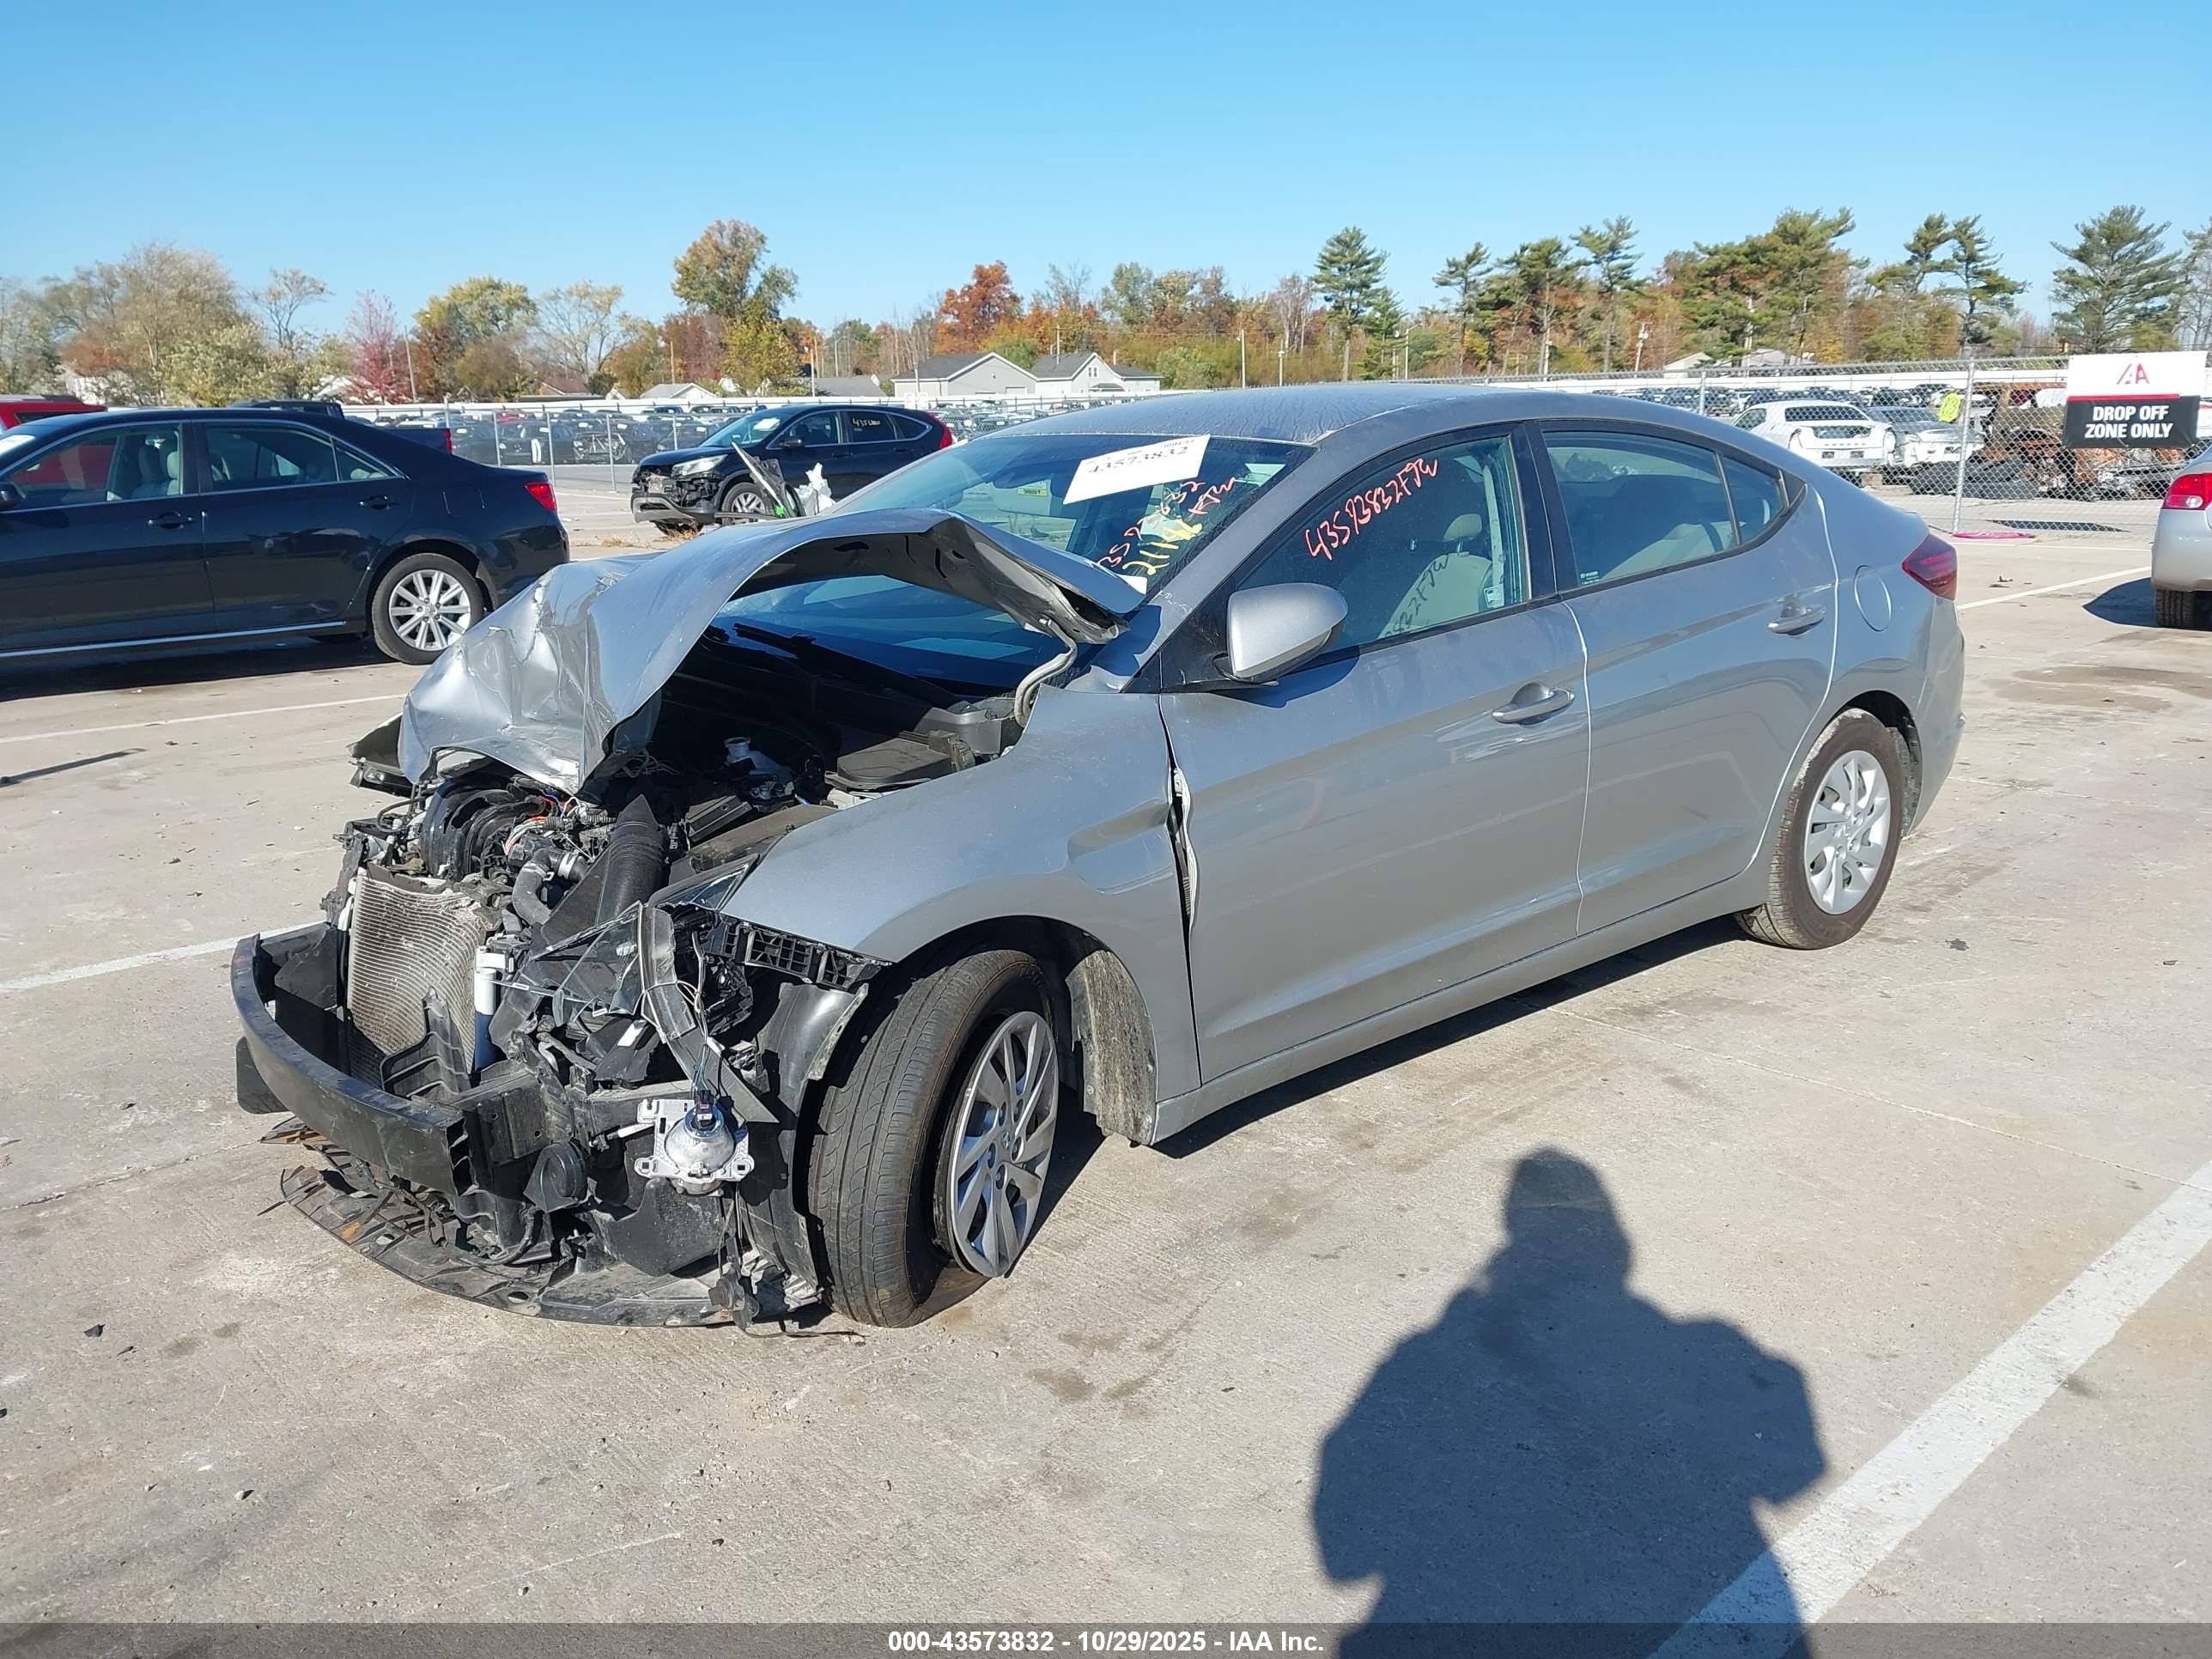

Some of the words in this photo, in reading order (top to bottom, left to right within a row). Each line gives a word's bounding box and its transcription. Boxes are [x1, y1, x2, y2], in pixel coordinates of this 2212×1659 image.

[2092, 405, 2136, 421] DROP
[2139, 405, 2169, 421] OFF
[2084, 422, 2128, 439] ZONE
[2130, 422, 2174, 439] ONLY
